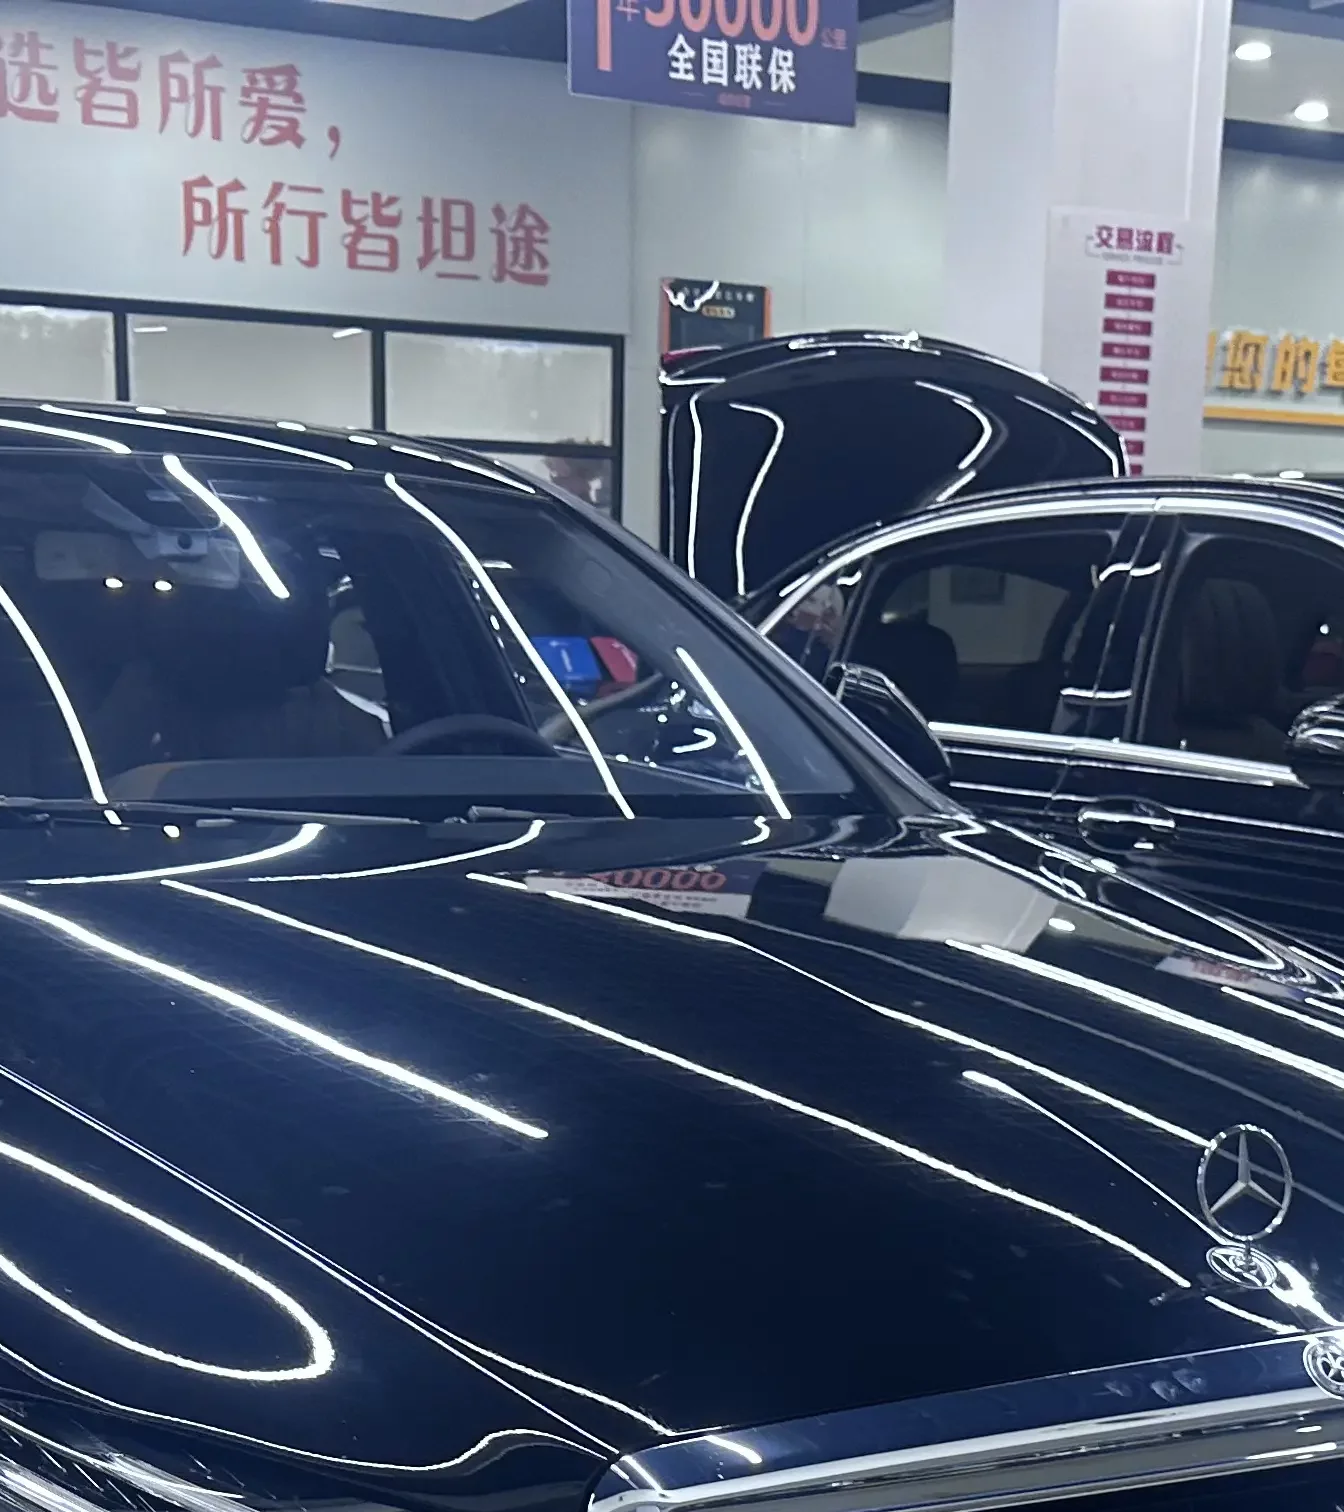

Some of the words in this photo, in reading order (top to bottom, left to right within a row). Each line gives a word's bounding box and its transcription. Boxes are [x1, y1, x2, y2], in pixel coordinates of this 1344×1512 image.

[667, 33, 796, 94] 全国联保
[182, 174, 551, 287] 所行皆坦途
